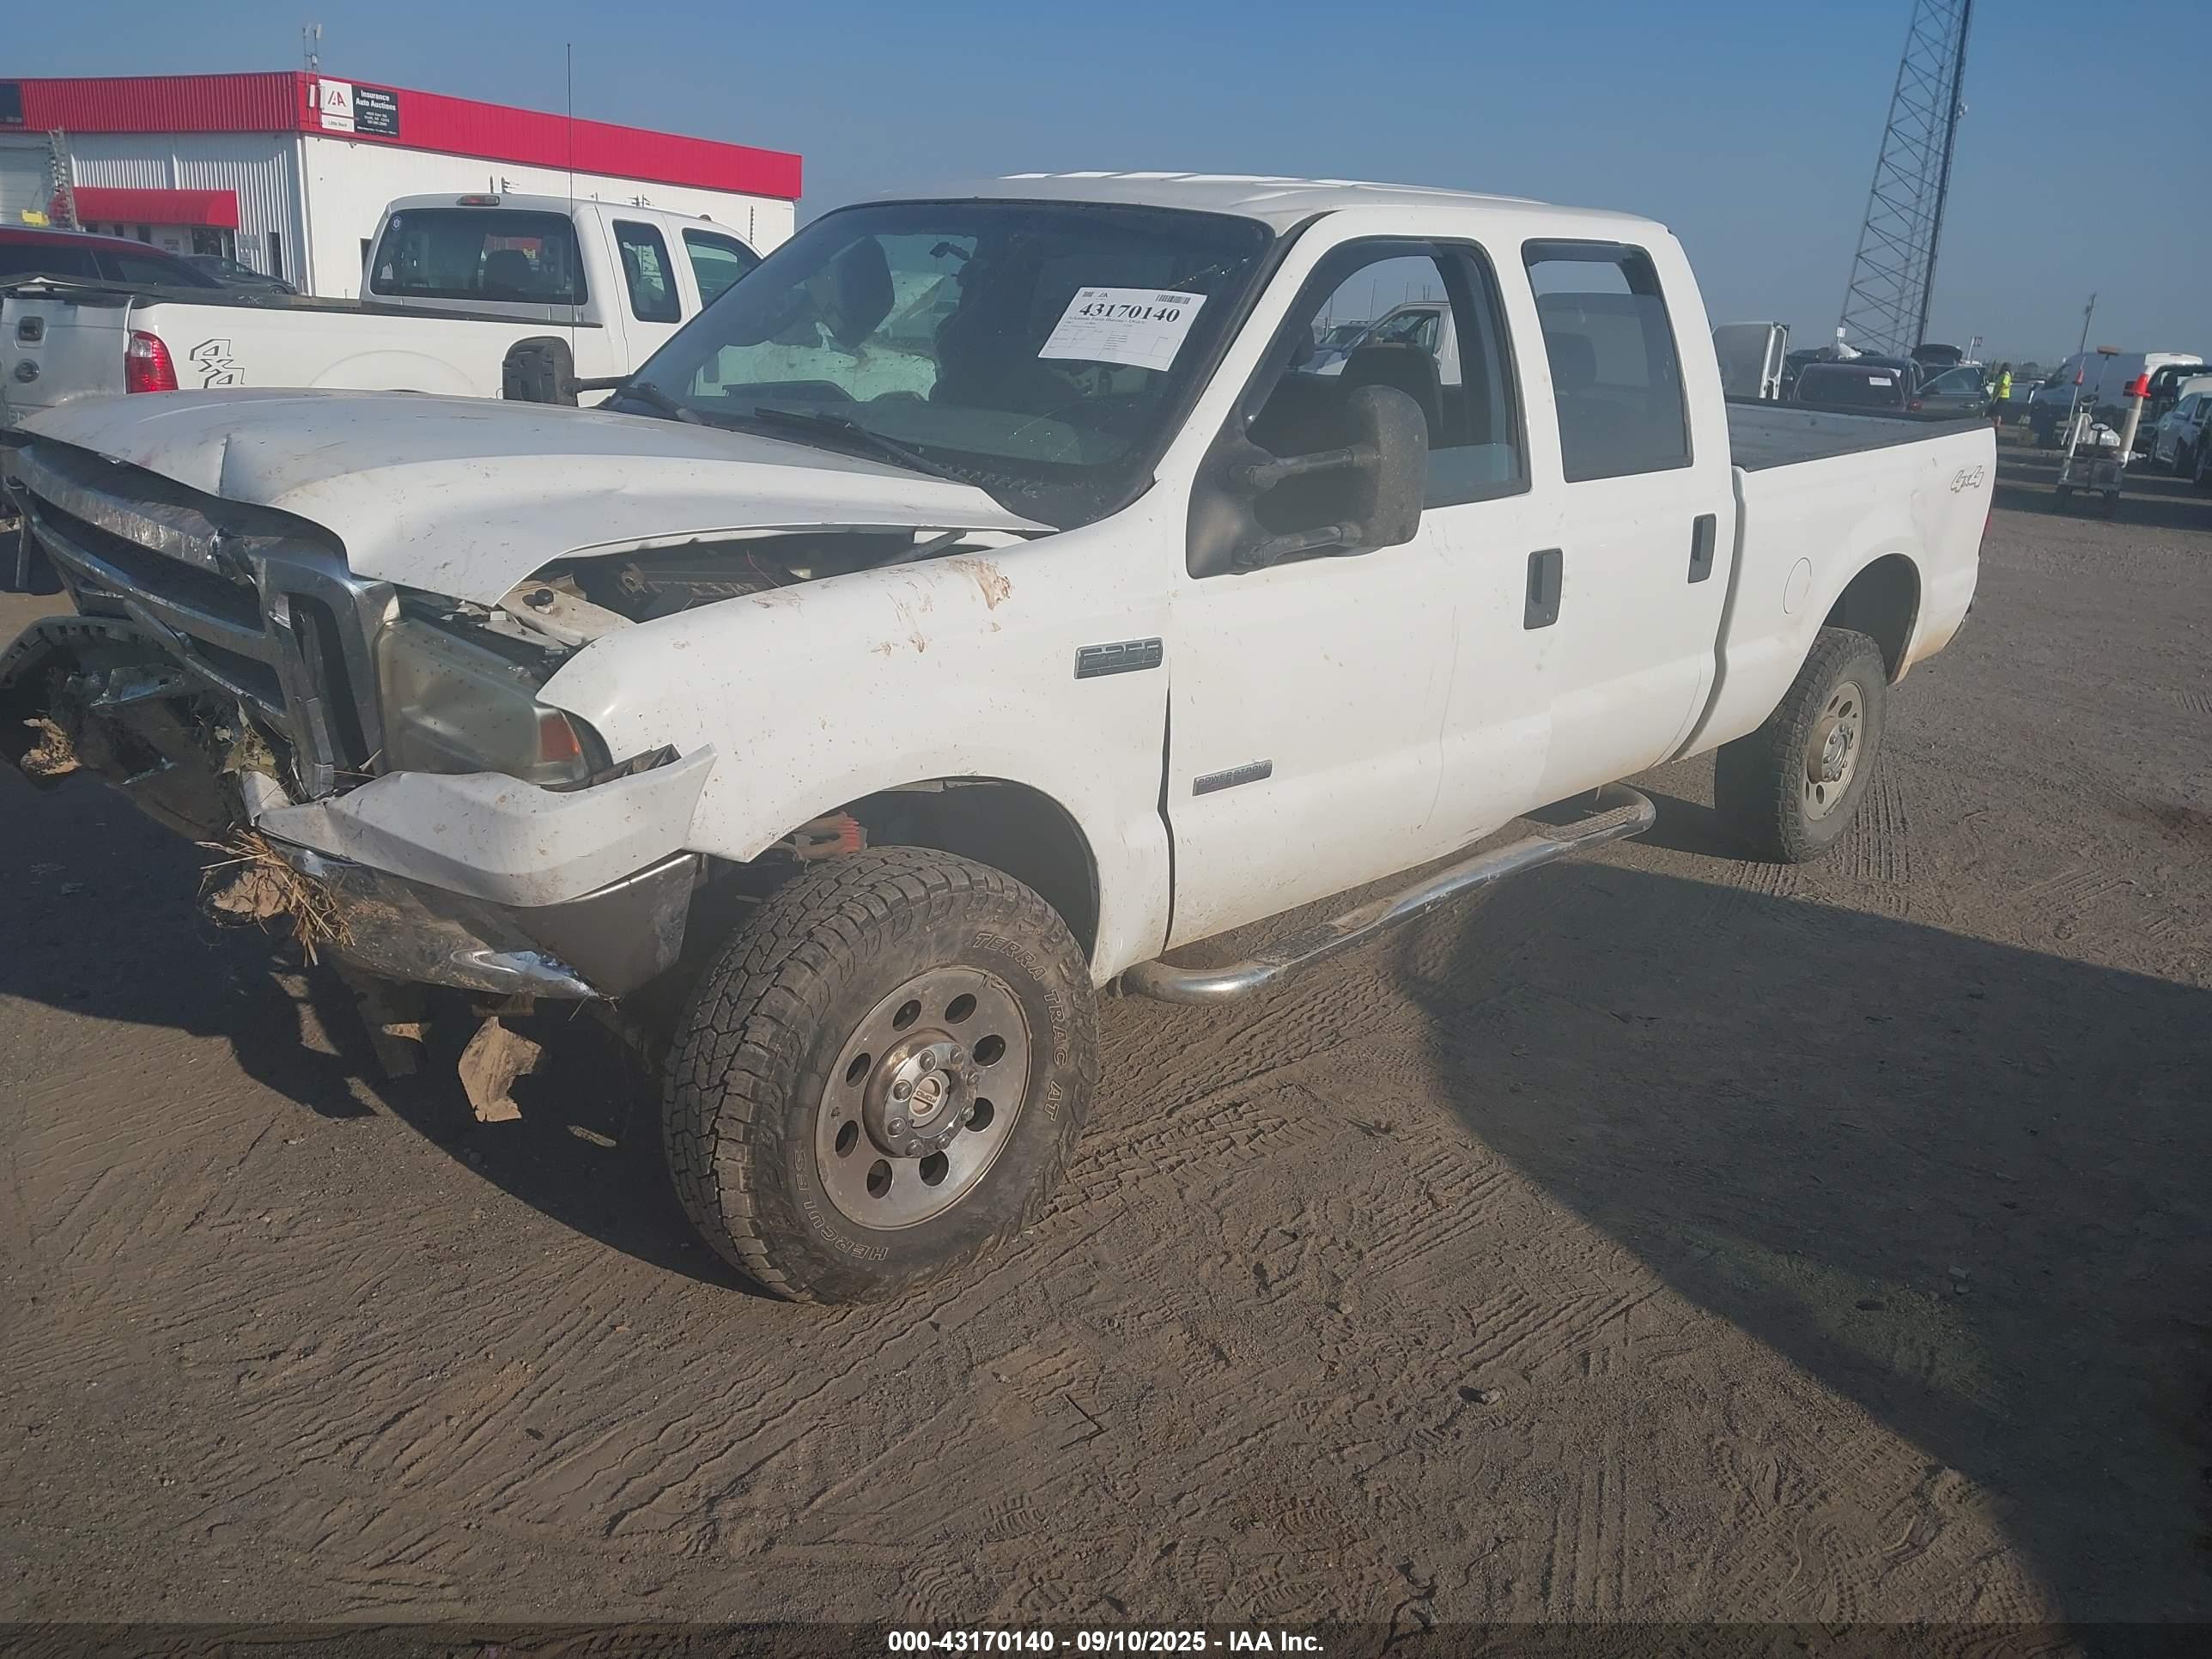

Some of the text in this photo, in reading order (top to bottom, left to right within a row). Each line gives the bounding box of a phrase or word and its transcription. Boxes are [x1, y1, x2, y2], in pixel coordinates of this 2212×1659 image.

[356, 97, 397, 111] Auto Auctions
[361, 89, 390, 101] Insurance
[1079, 302, 1181, 323] 43170140
[972, 932, 1068, 1121] TERRA TRAC AT
[794, 1149, 889, 1261] HERCULES
